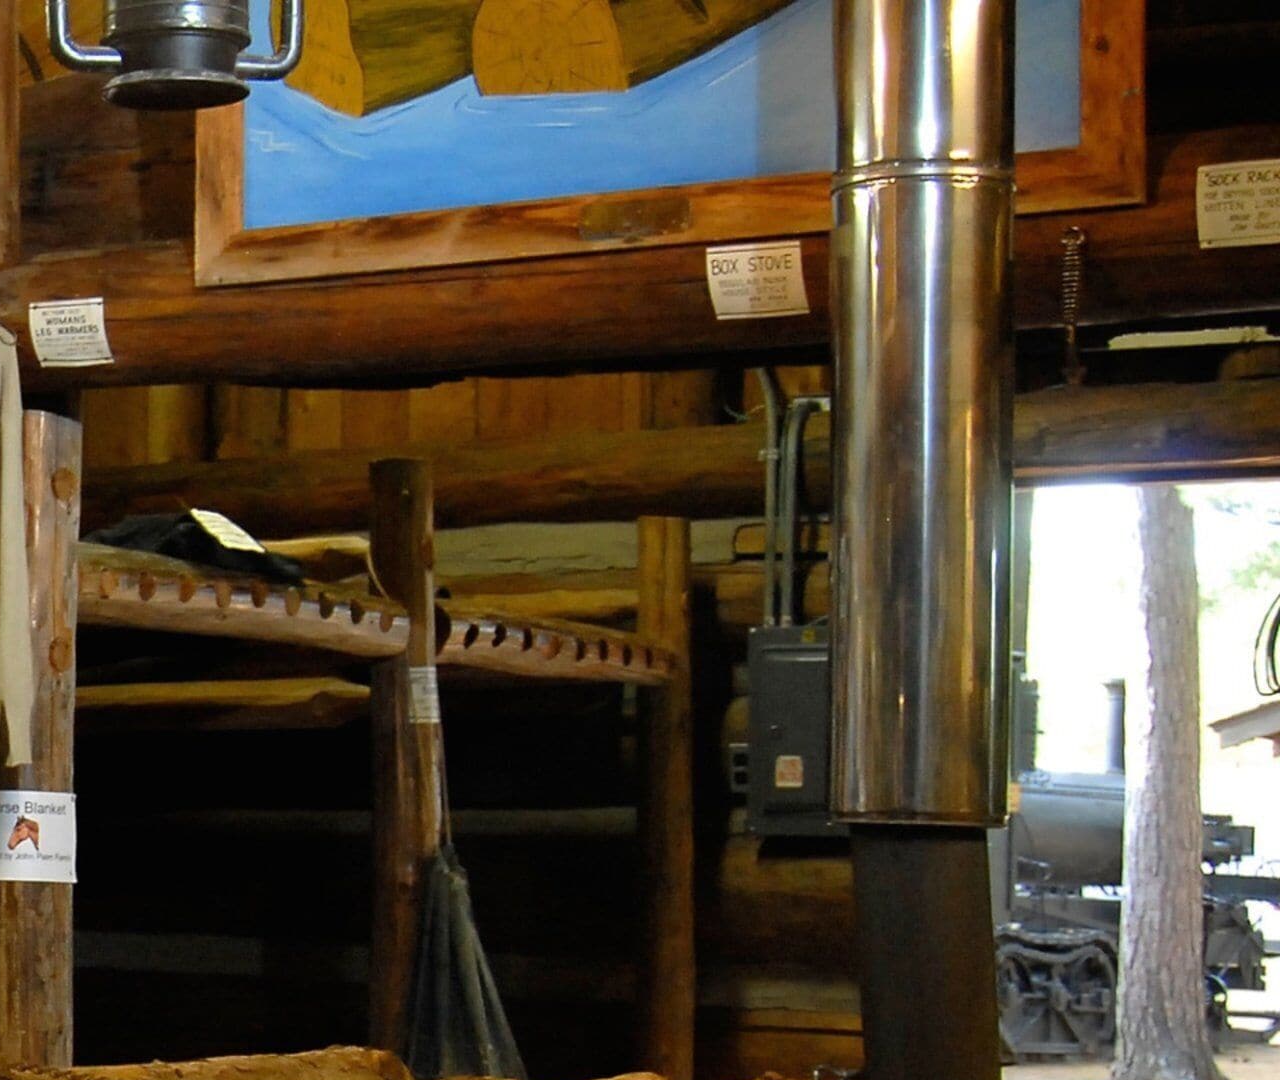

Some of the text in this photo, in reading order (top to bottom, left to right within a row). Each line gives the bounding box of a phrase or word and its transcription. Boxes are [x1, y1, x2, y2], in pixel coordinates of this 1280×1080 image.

[711, 254, 792, 276] BOX STOVE
[35, 328, 52, 337] LEG
[24, 801, 66, 815] Blanket
